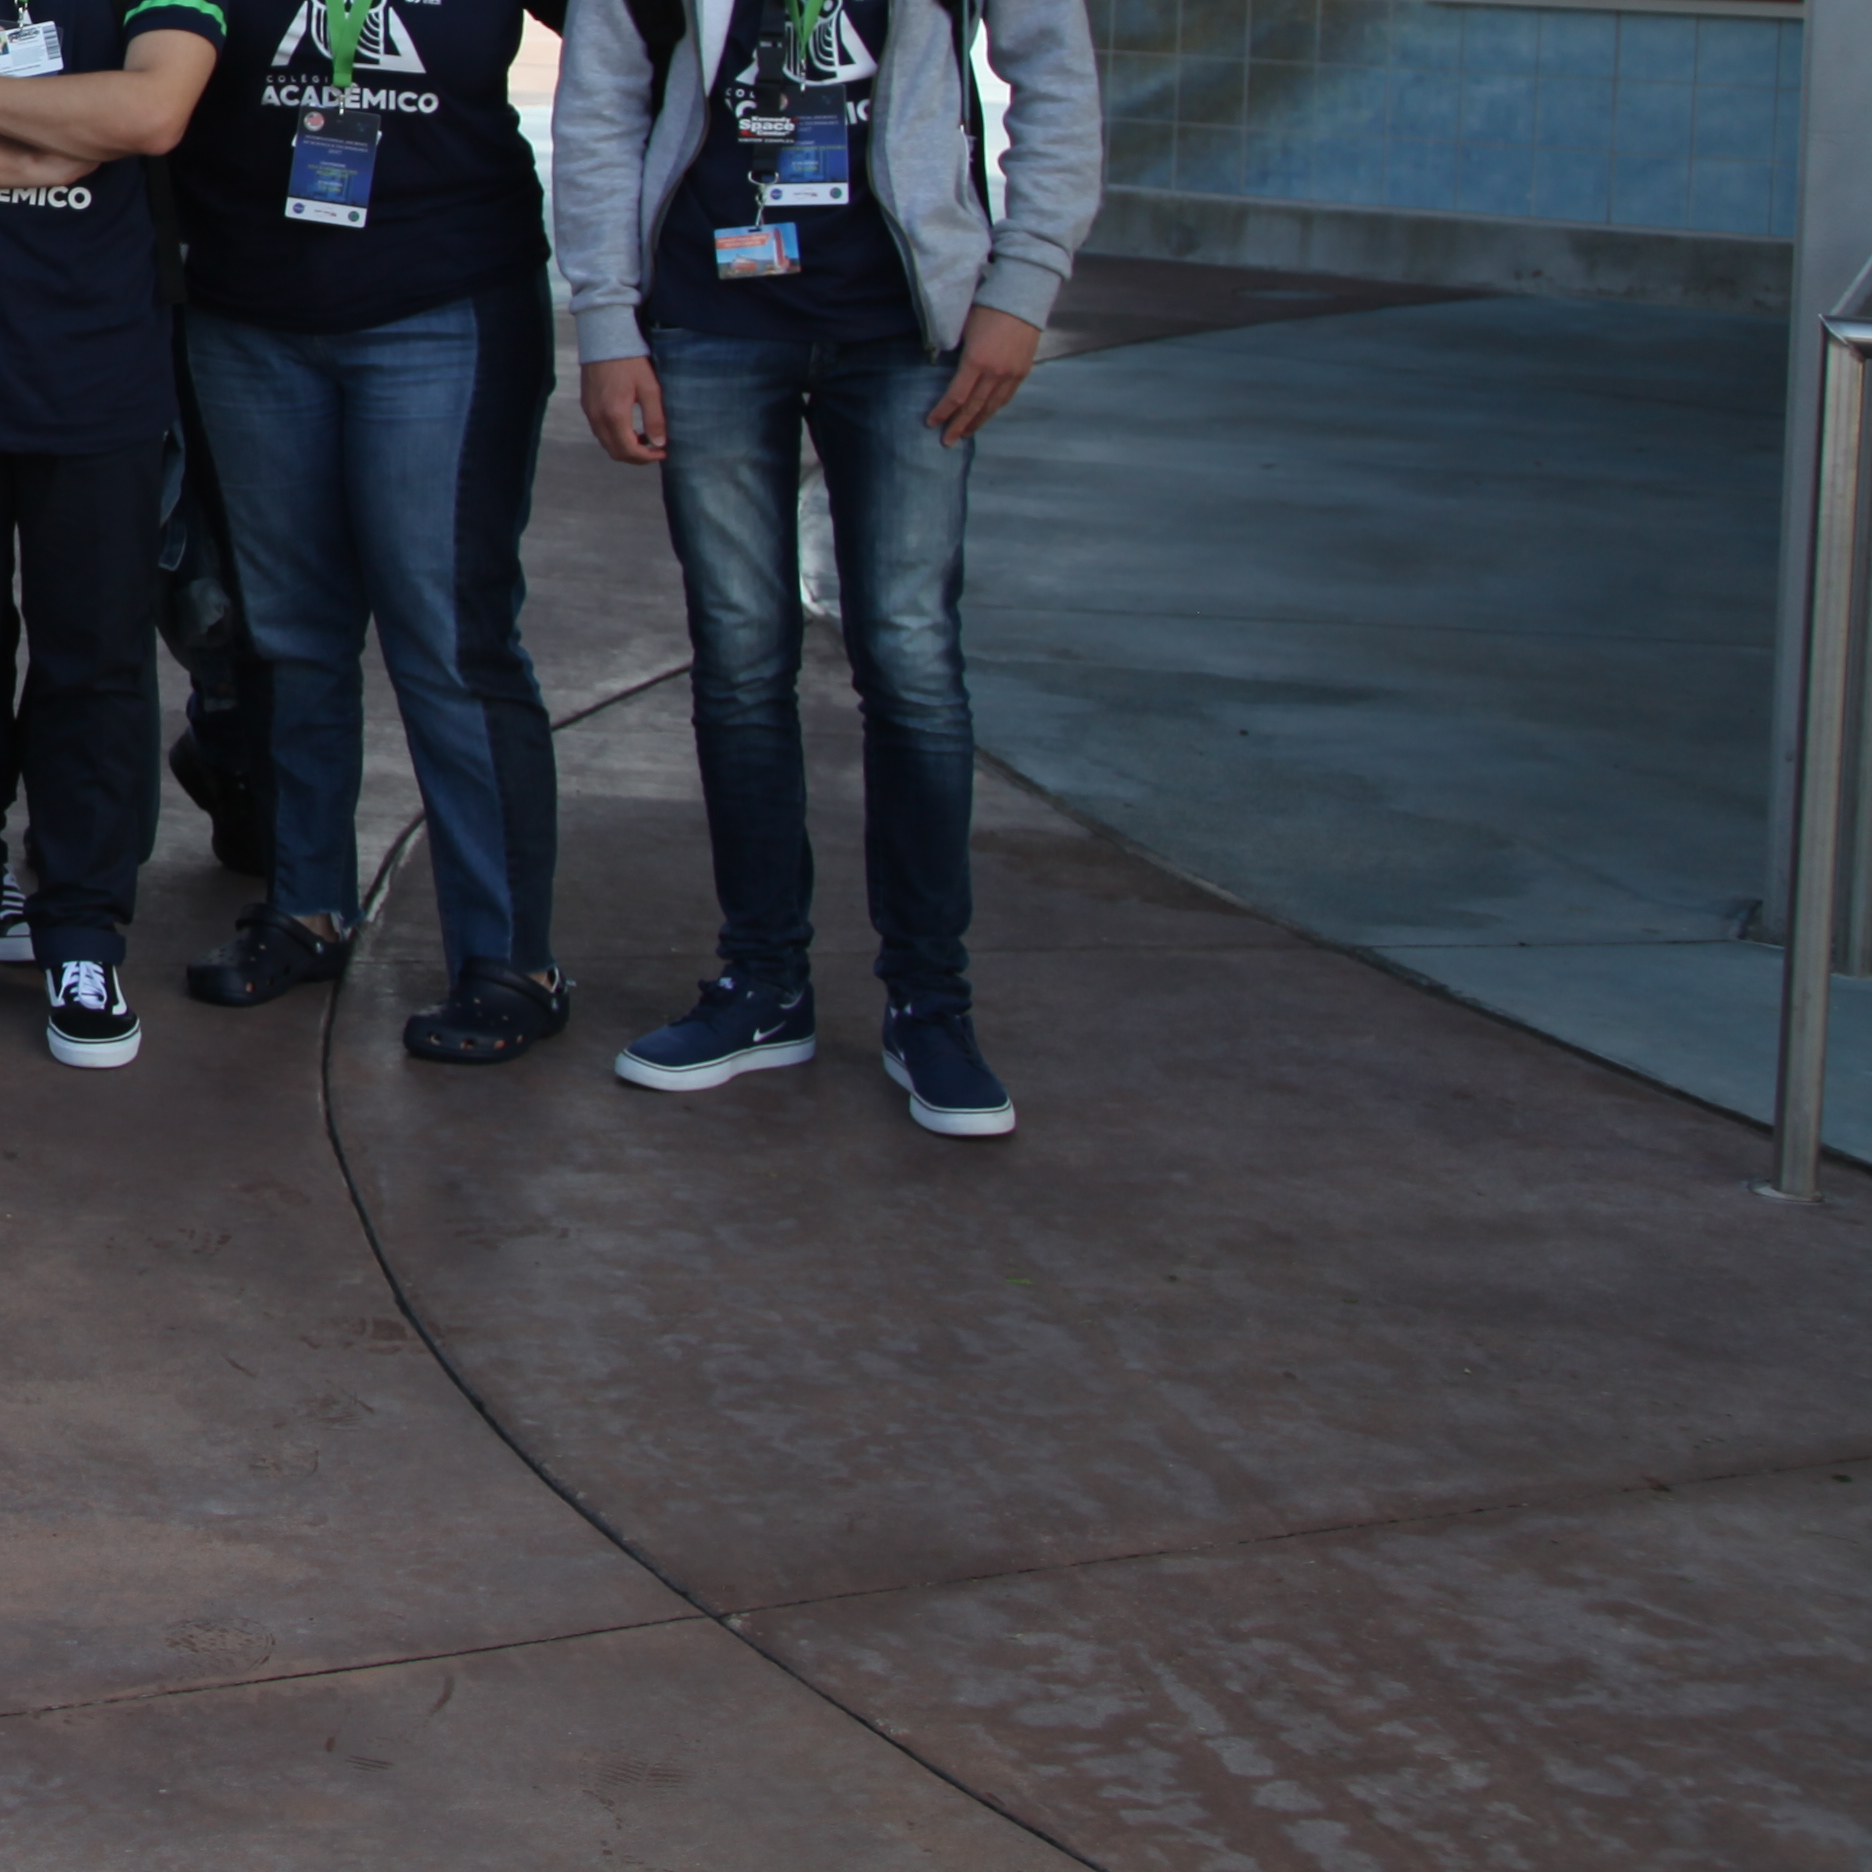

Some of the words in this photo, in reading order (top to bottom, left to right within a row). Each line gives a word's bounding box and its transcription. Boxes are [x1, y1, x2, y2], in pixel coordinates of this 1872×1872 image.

[266, 73, 329, 84] COLÉGI
[260, 82, 440, 115] ACADÊMICO
[738, 118, 796, 134] Space
